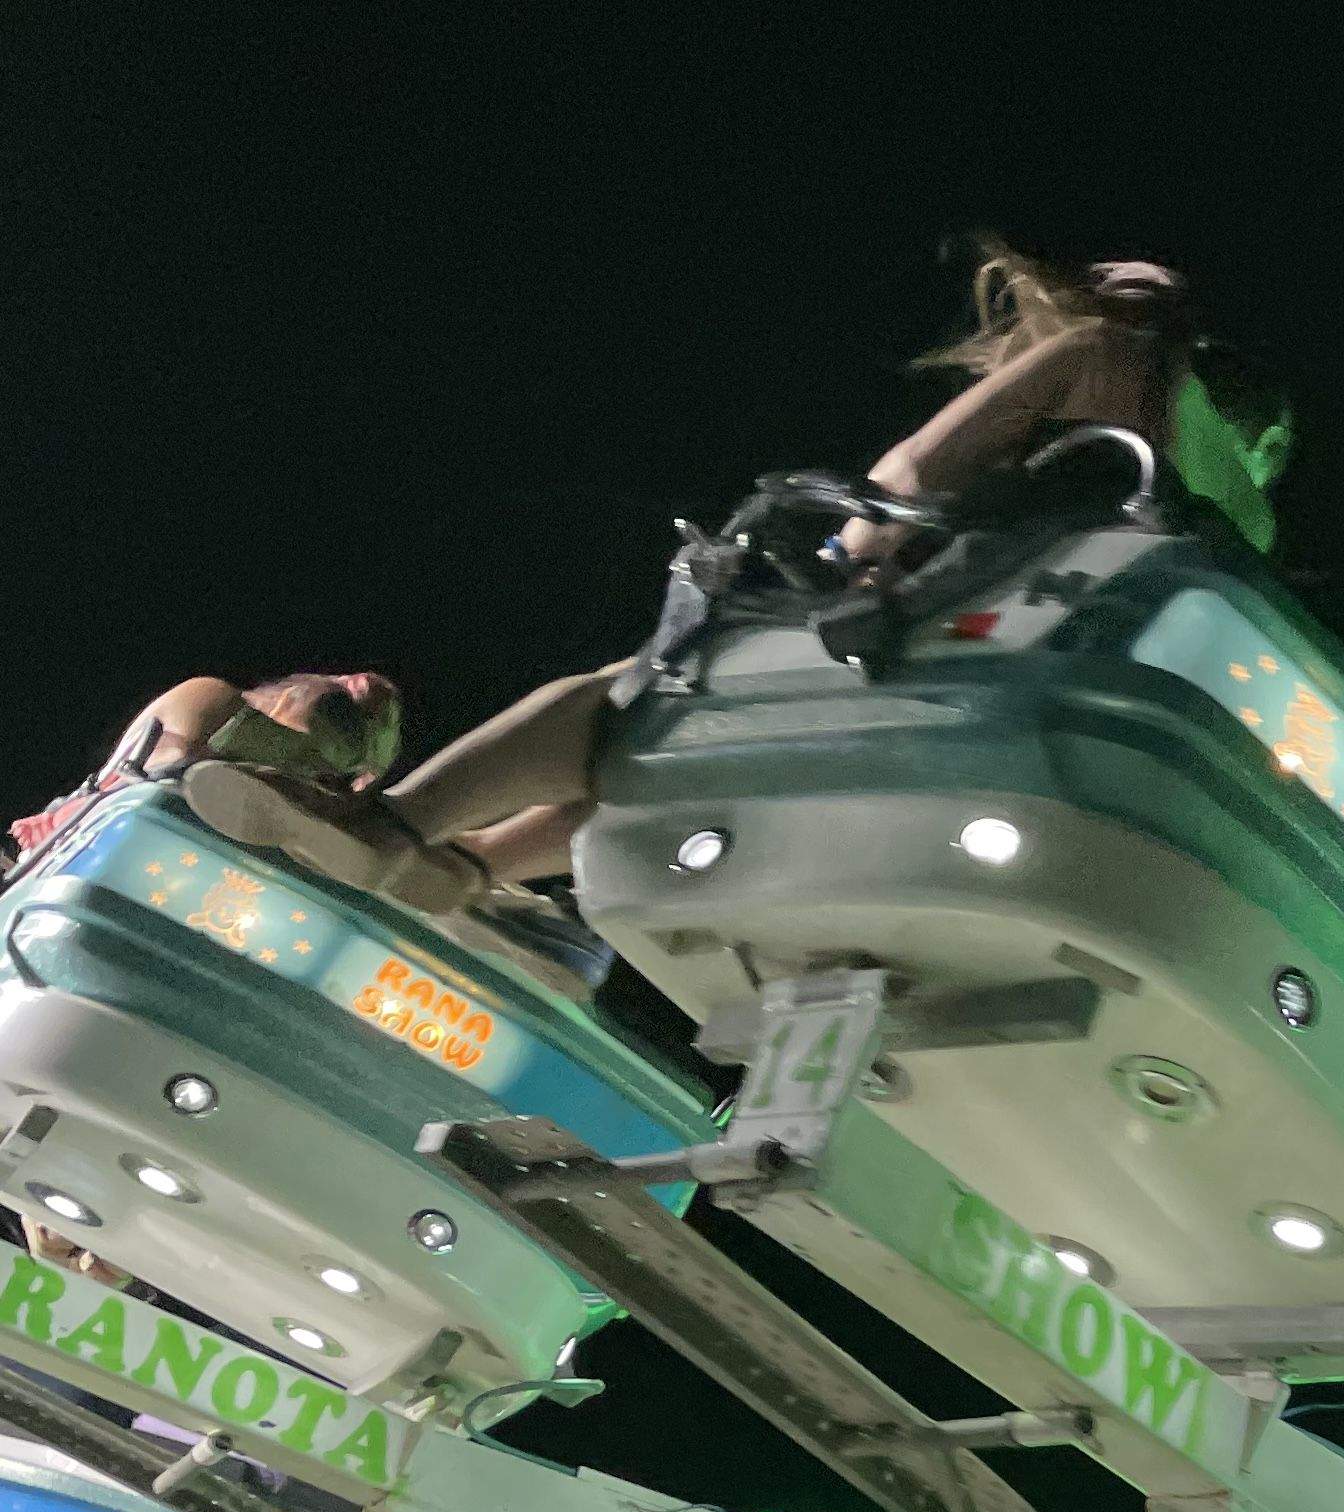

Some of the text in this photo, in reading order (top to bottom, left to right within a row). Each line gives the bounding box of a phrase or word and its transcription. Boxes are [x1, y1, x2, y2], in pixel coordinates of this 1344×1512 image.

[353, 984, 485, 1071] SHOW
[376, 956, 494, 1044] RANA
[752, 1017, 846, 1108] 14
[951, 1194, 1200, 1432] SHOW
